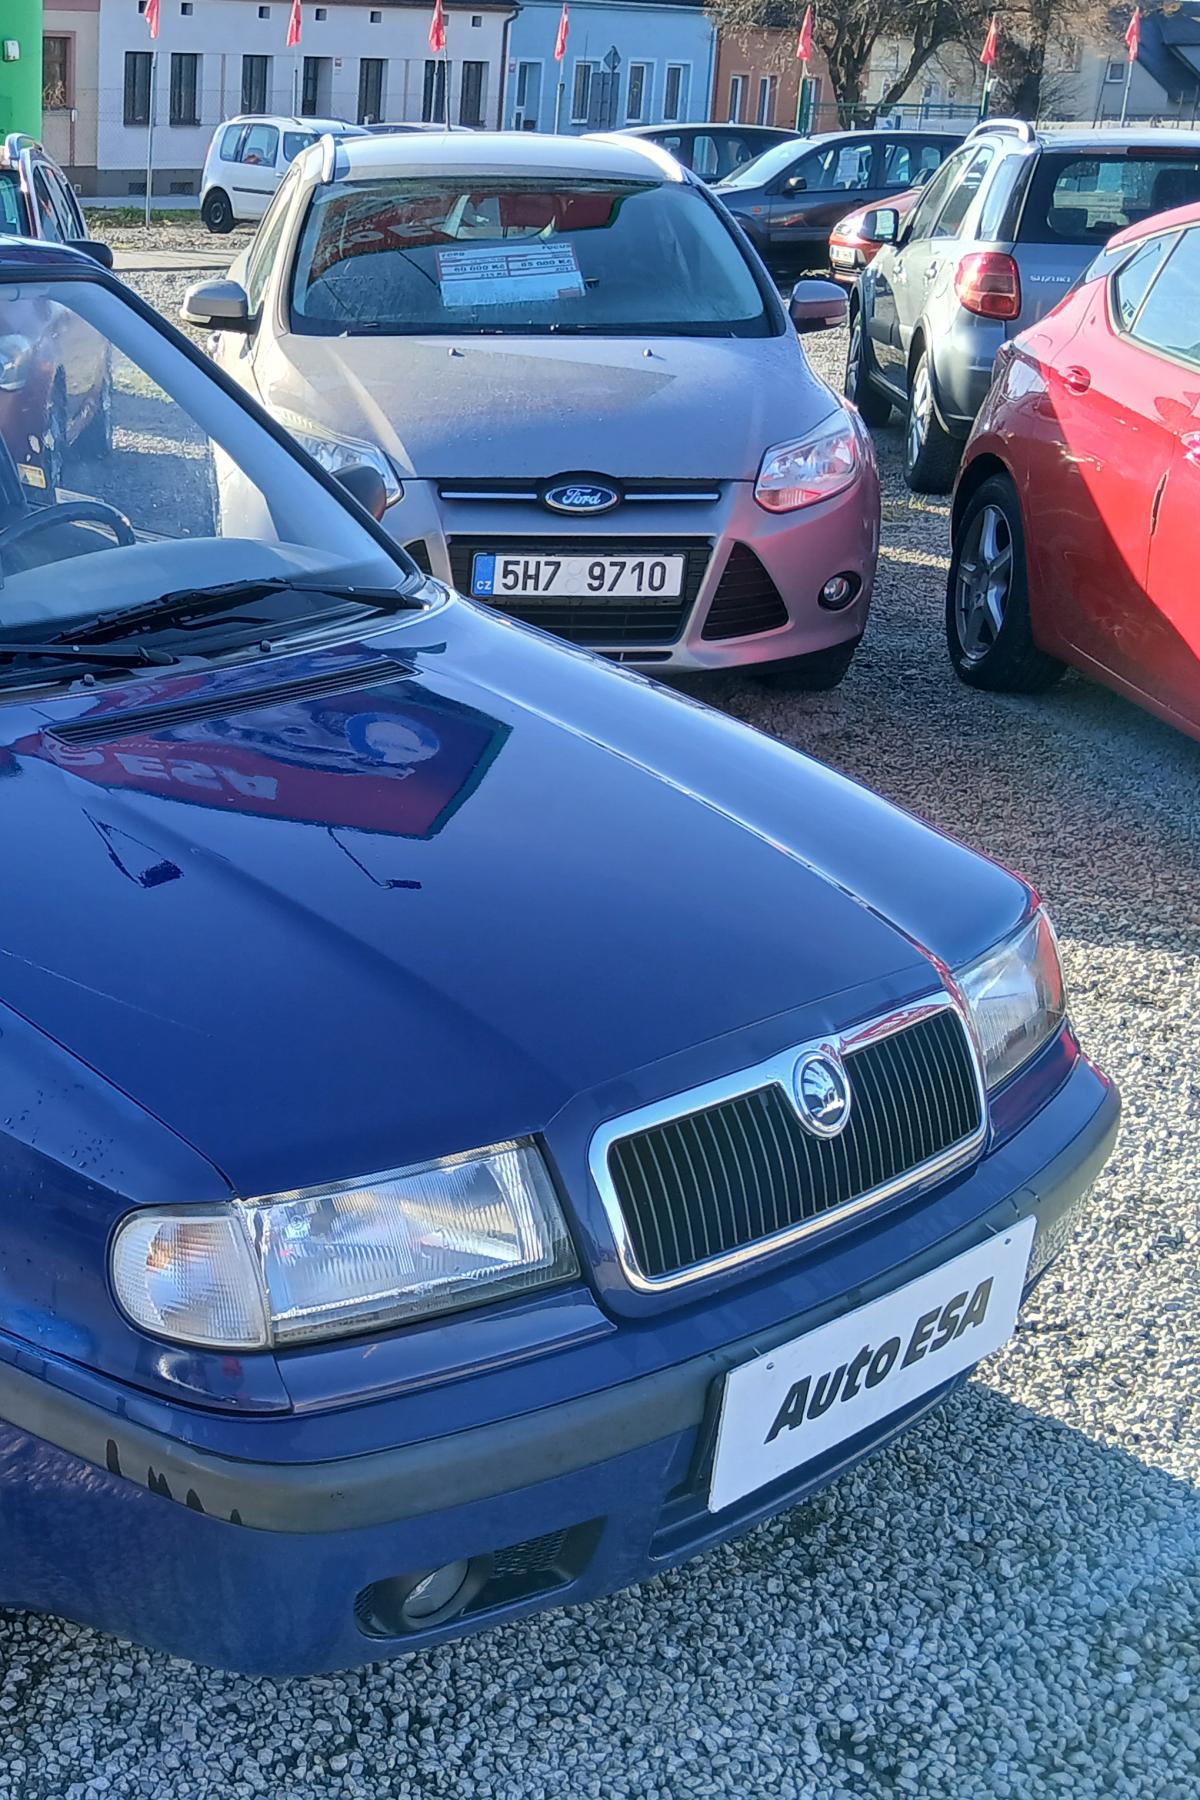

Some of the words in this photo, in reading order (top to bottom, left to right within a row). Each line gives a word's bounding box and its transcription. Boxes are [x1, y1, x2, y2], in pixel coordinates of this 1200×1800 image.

[562, 488, 602, 505] Ford
[476, 579, 492, 591] CZ
[501, 560, 562, 592] 5H7
[586, 560, 667, 593] 9710
